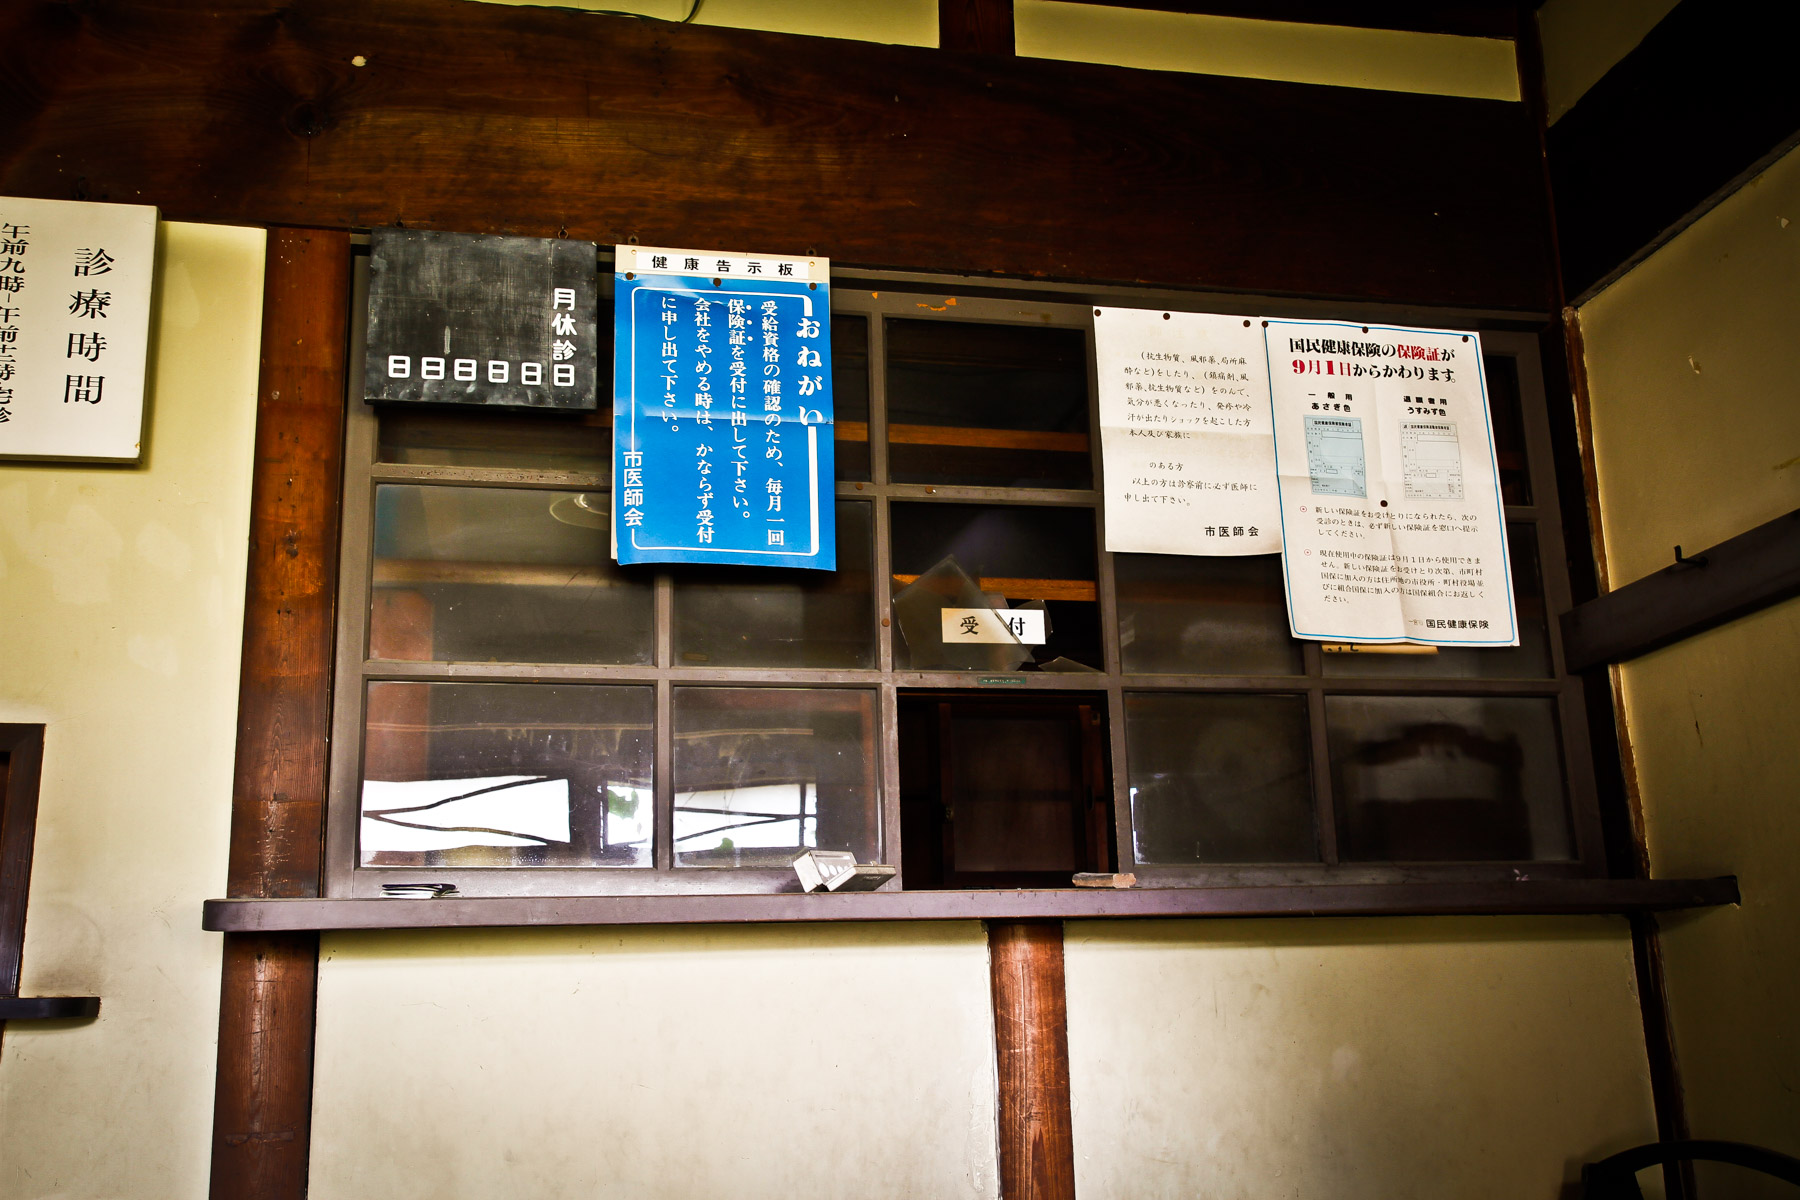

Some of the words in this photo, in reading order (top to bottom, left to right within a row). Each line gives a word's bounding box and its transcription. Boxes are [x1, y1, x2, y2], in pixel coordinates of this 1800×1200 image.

[651, 255, 794, 277] 健康告示板
[64, 248, 115, 405] 診療時間
[551, 287, 578, 387] 月休診日
[1289, 337, 1456, 362] 国民健康保険の保険証が
[660, 296, 680, 433] に申し出て下さい。
[796, 317, 824, 426] おねがい
[1292, 359, 1456, 383] 9月1日からかわります。
[694, 297, 716, 544] 会社をやめる時は、かならず受付
[727, 298, 752, 519] 保険証を受付に出して下さい。
[760, 300, 786, 547] 受給資格の確認のため、毎月一回
[1129, 428, 1190, 439] 本人及び家族に
[1149, 462, 1184, 472] のある方
[623, 451, 645, 527] 市医師会
[1132, 477, 1258, 492] 以上の方は診察前に必ず医師に
[1124, 492, 1190, 507] 申し出て下さい。
[1204, 526, 1260, 538] 市医師会
[960, 616, 1026, 636] 受付
[1425, 619, 1489, 630] 国民健康保険
